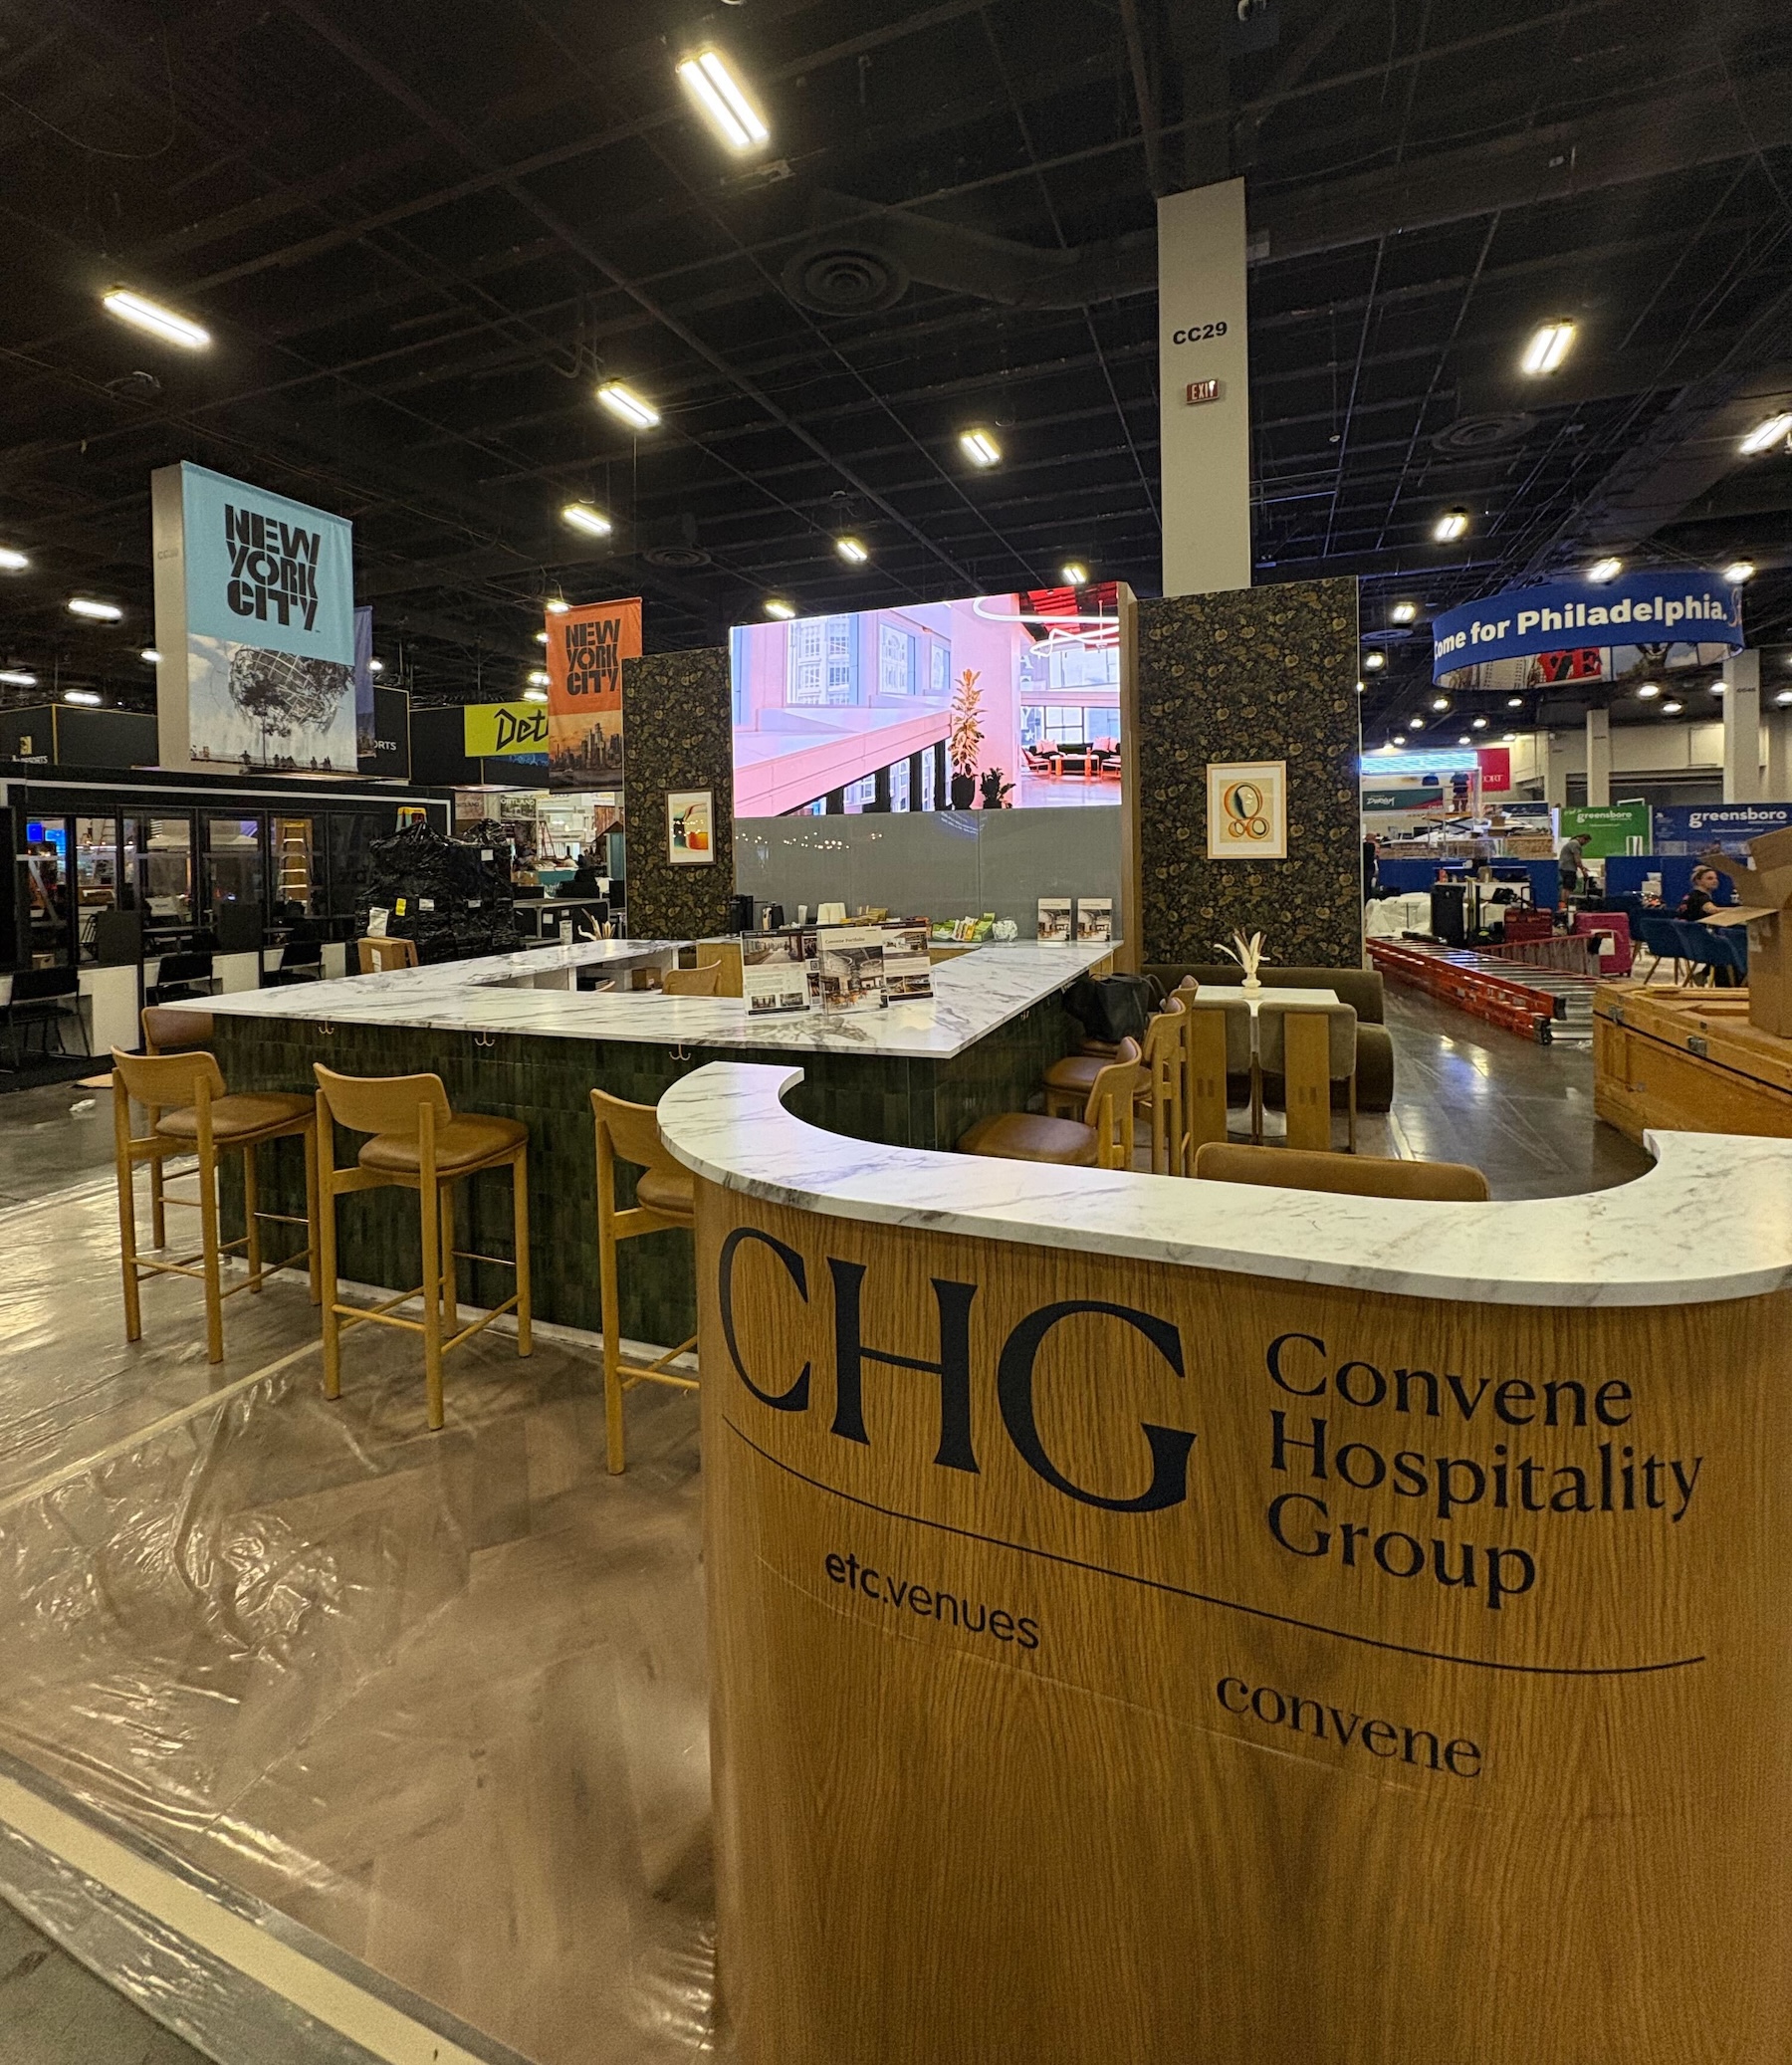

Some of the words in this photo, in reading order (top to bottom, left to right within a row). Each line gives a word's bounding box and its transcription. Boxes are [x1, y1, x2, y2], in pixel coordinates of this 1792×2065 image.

[1173, 321, 1228, 344] CC29
[1192, 379, 1217, 399] EXIT
[225, 503, 321, 566] NEW
[226, 540, 319, 606] YORK
[227, 579, 319, 631] CITY
[1469, 620, 1511, 645] for
[1517, 592, 1727, 635] Philadelphia.
[565, 618, 620, 648] NEW
[566, 644, 619, 677] YORK
[567, 668, 618, 695] CITY
[1576, 809, 1633, 823] greensboro
[1688, 806, 1787, 828] greensboro
[719, 1228, 1197, 1513] CHG
[1266, 1333, 1634, 1428] Convene
[1268, 1408, 1703, 1523] Hospitality
[1267, 1492, 1536, 1611] Group
[824, 1553, 1040, 1650] etc.venues
[1217, 1677, 1482, 1778] convene
